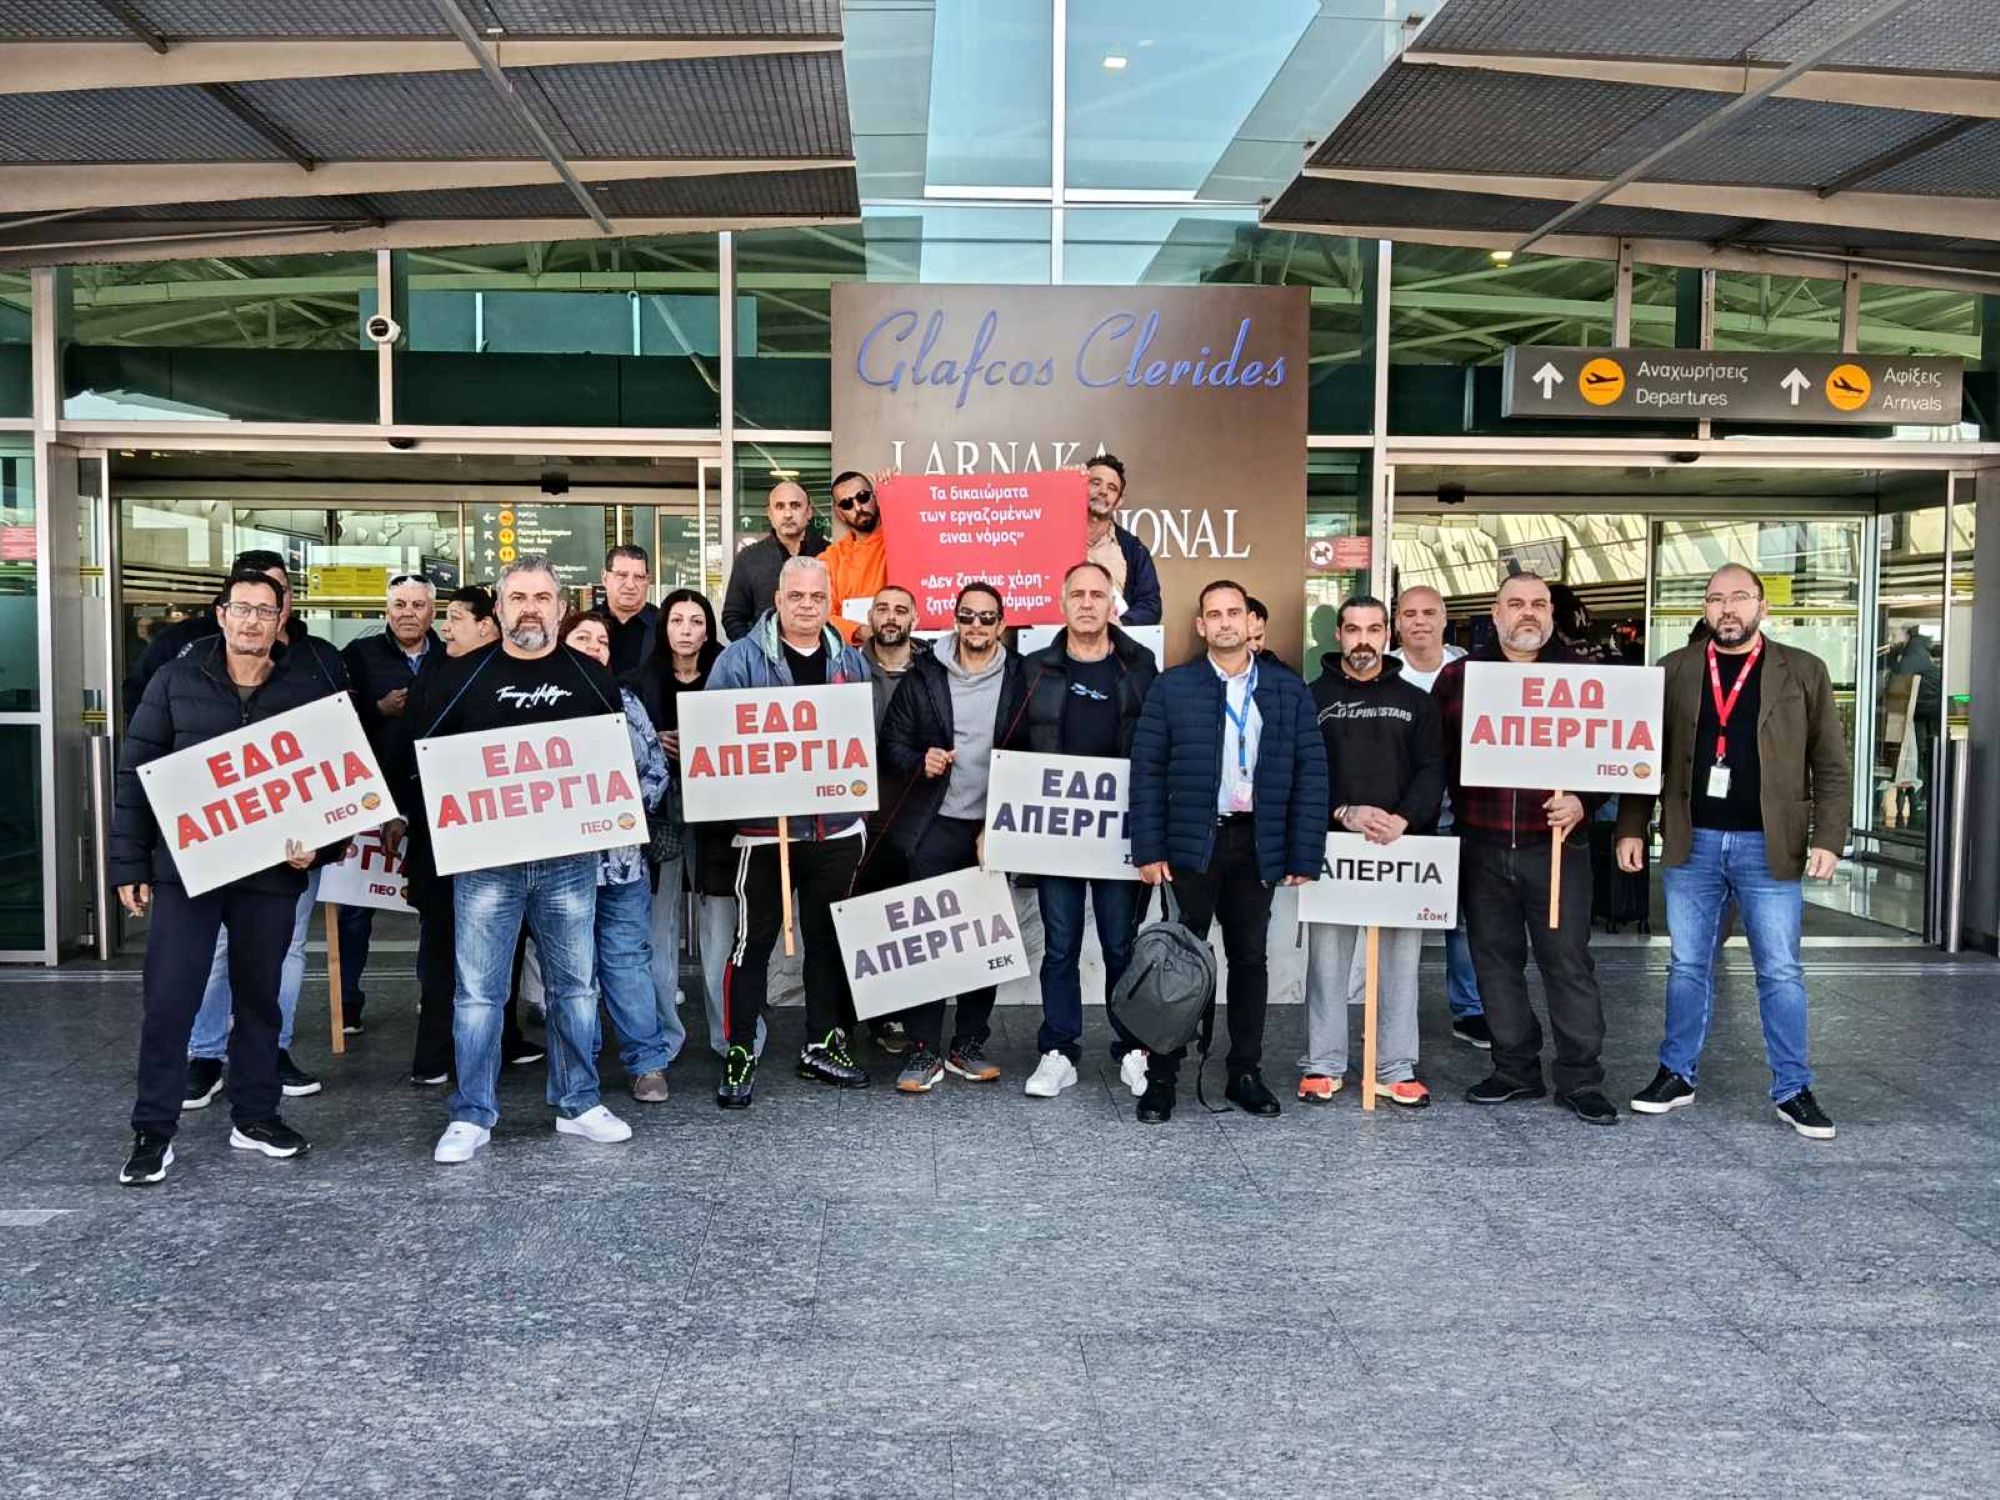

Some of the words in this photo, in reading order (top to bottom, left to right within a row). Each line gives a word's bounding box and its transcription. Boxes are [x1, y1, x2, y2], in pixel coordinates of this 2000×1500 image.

[857, 309, 1058, 408] Glafcos
[1075, 310, 1287, 389] Clerides
[1637, 361, 1749, 383] Αναχωρήσεις
[1883, 367, 1943, 388] Αφίξεις
[1636, 388, 1729, 408] Departures
[1882, 394, 1943, 411] Arrivals
[929, 486, 947, 500] Τα
[950, 483, 1029, 504] δικαιώματα
[920, 510, 947, 523] των
[950, 504, 1042, 526] εργαζομένων
[1008, 569, 1042, 589] χάρη
[1521, 677, 1605, 709] ΕΔΩ
[735, 700, 818, 735] ΕΔΩ
[1469, 714, 1655, 751] ΑΠΕΡΓΙΑ
[207, 730, 304, 789] ΕΔΩ
[481, 736, 573, 778] ΕΔΩ
[687, 738, 869, 778] ΑΠΕΡΓΙΑ
[1597, 764, 1629, 777] ΠΕΟ
[816, 785, 847, 797] ΠΕΟ
[1041, 768, 1117, 802] ΕΔΩ
[177, 751, 373, 850] ΑΠΕΡΓΙΑ
[437, 770, 634, 829] ΑΠΕΡΓΙΑ
[325, 804, 358, 825] ΠΕΟ
[581, 819, 612, 835] ΠΕΟ
[991, 802, 1131, 839] ΑΠΕΡΓΙ
[1320, 857, 1442, 884] ΑΠΕΡΓΙΑ
[369, 883, 397, 896] ΠΕΟ
[885, 889, 962, 932] ΕΔΩ
[855, 914, 1014, 980] ΑΠΕΡΓΙΑ
[987, 954, 1015, 971] ΣΕΚ
